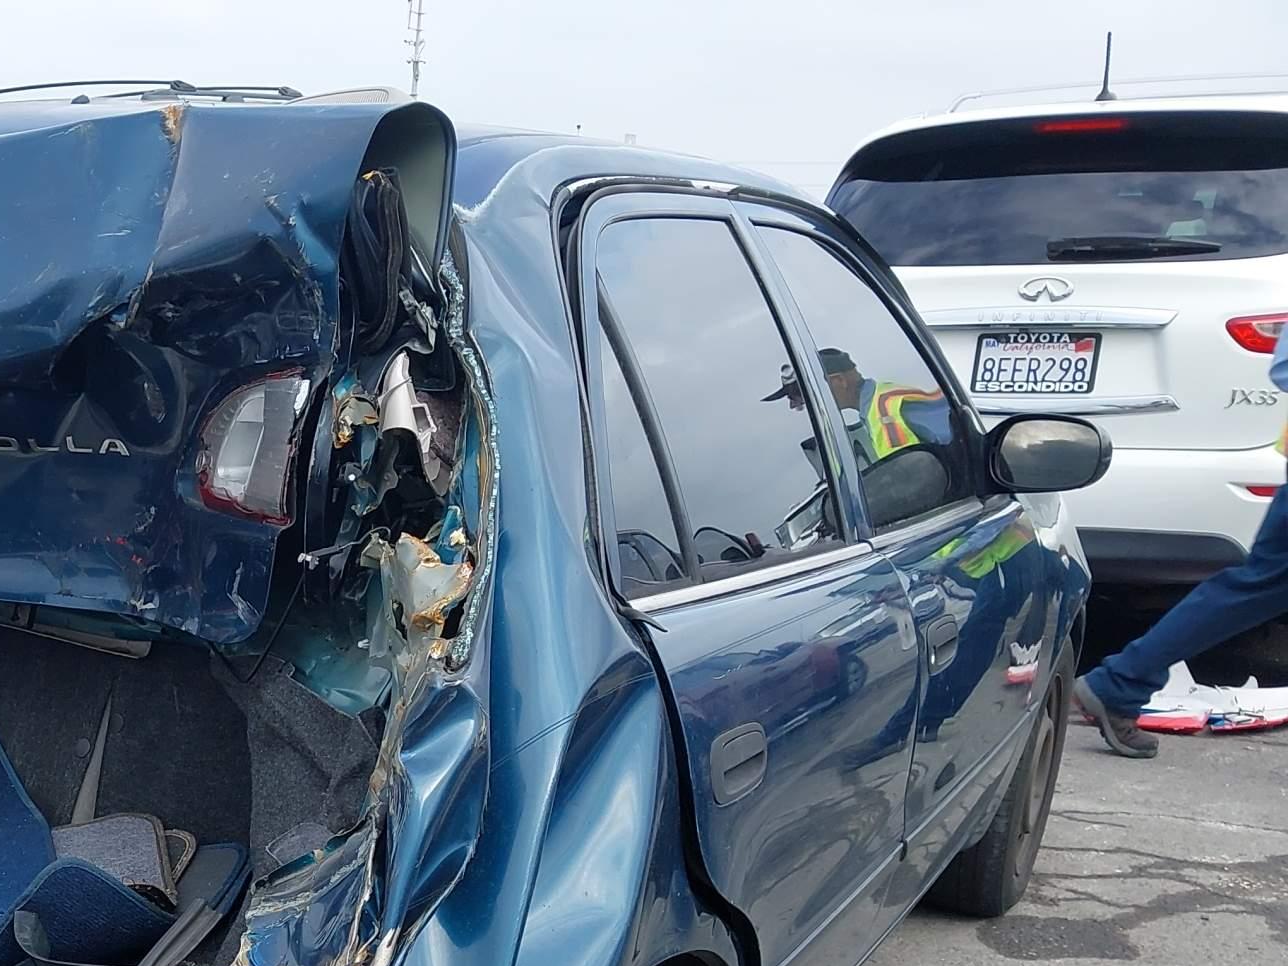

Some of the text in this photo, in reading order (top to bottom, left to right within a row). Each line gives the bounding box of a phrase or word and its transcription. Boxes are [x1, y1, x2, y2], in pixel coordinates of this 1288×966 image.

[977, 311, 1104, 322] INFINITI
[1007, 333, 1071, 343] TOYOTA
[975, 381, 1088, 392] ESCONDIDO
[1223, 389, 1280, 409] JX35
